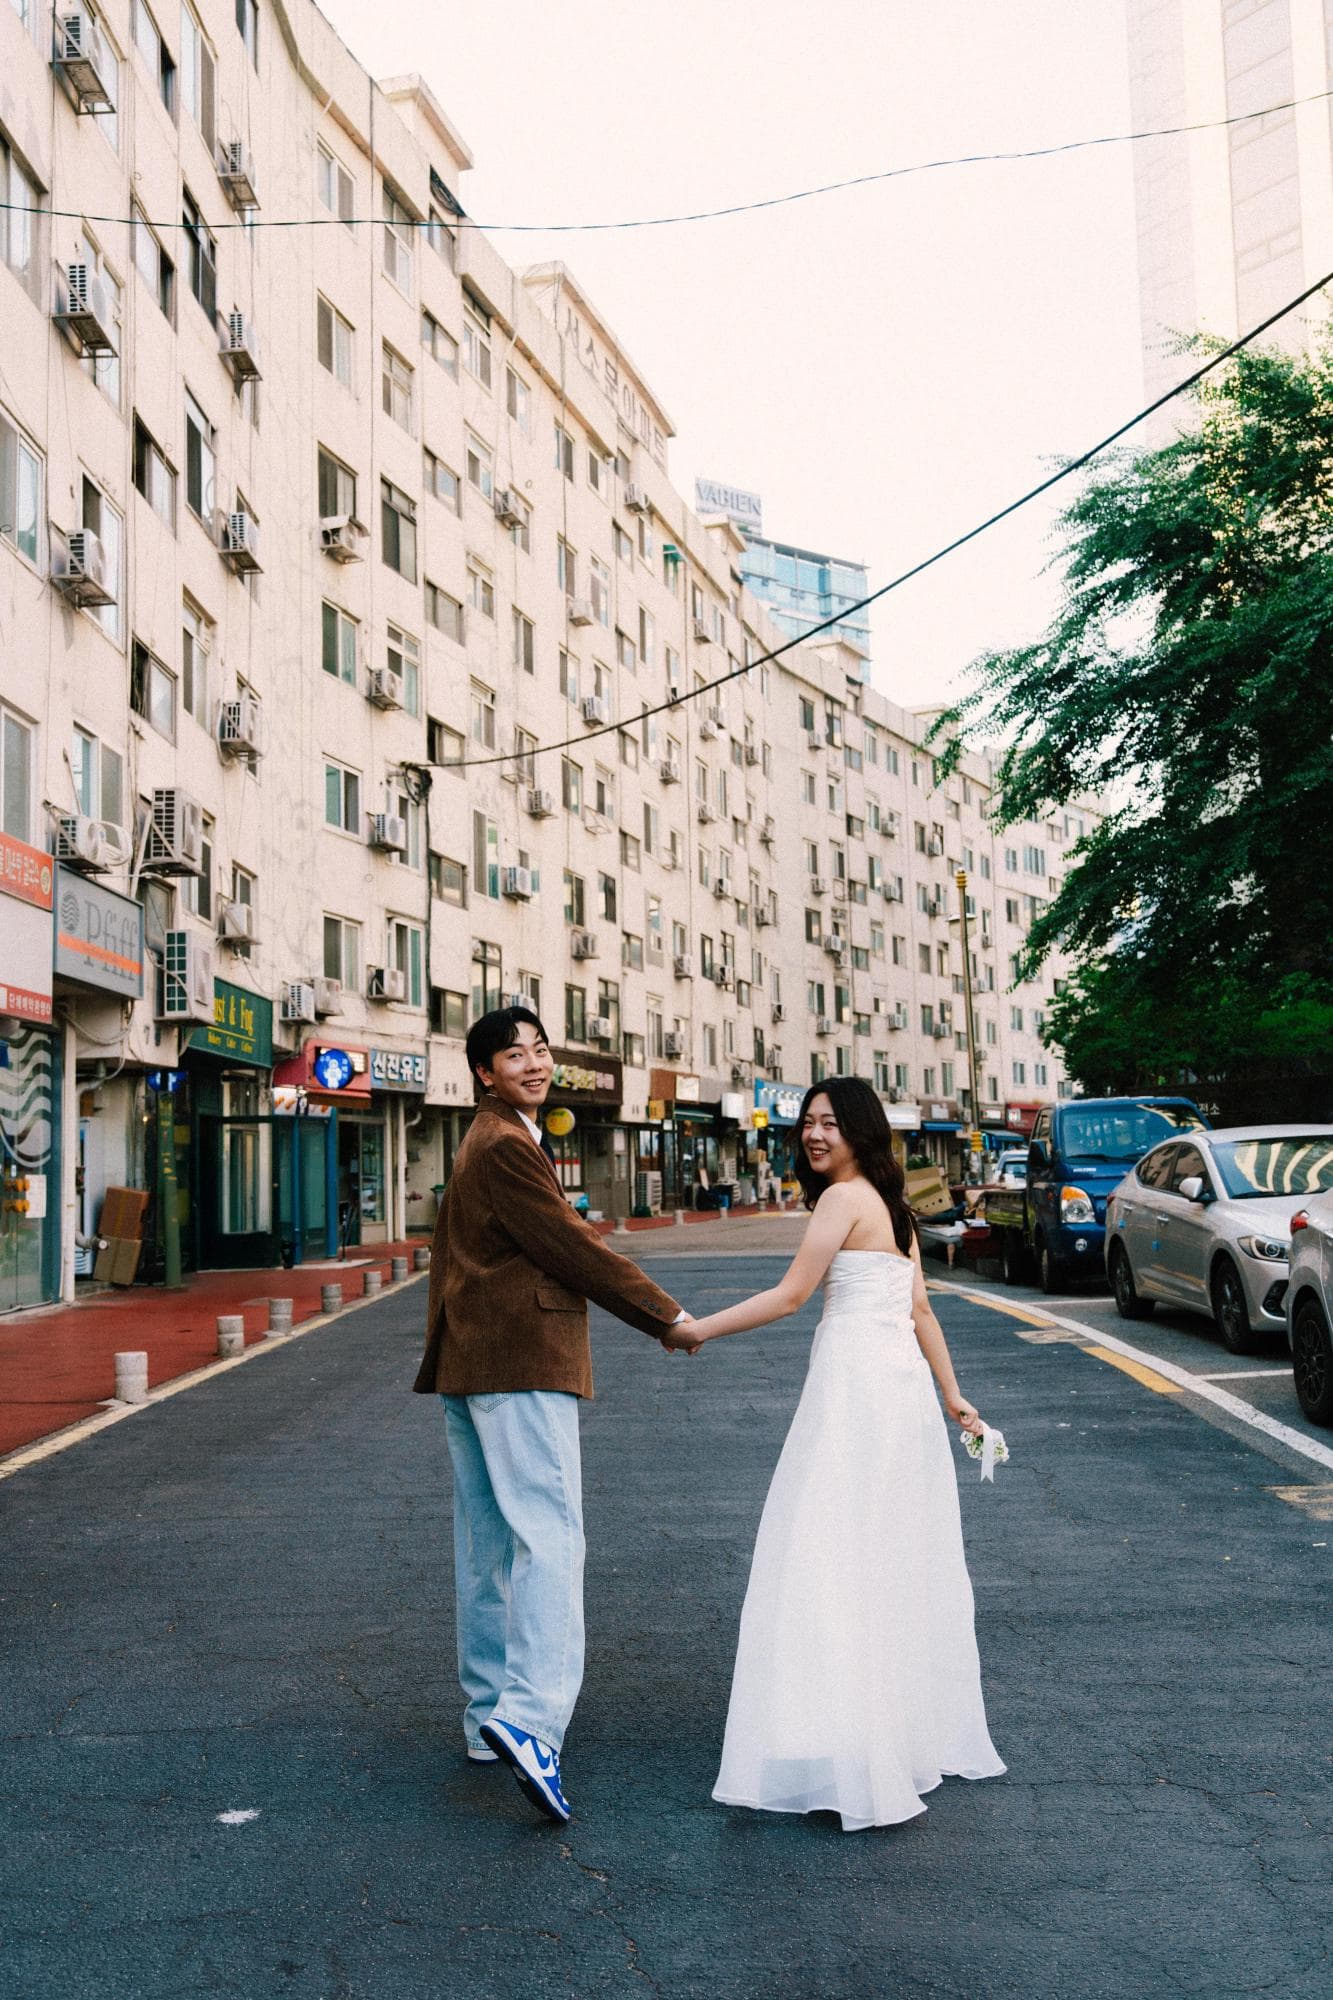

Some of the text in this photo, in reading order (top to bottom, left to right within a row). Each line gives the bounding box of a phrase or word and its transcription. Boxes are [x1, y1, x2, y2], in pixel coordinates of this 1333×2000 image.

[84, 900, 138, 981] Pfiff
[214, 995, 254, 1036] ust & Fog
[374, 1052, 425, 1083] 신진유리
